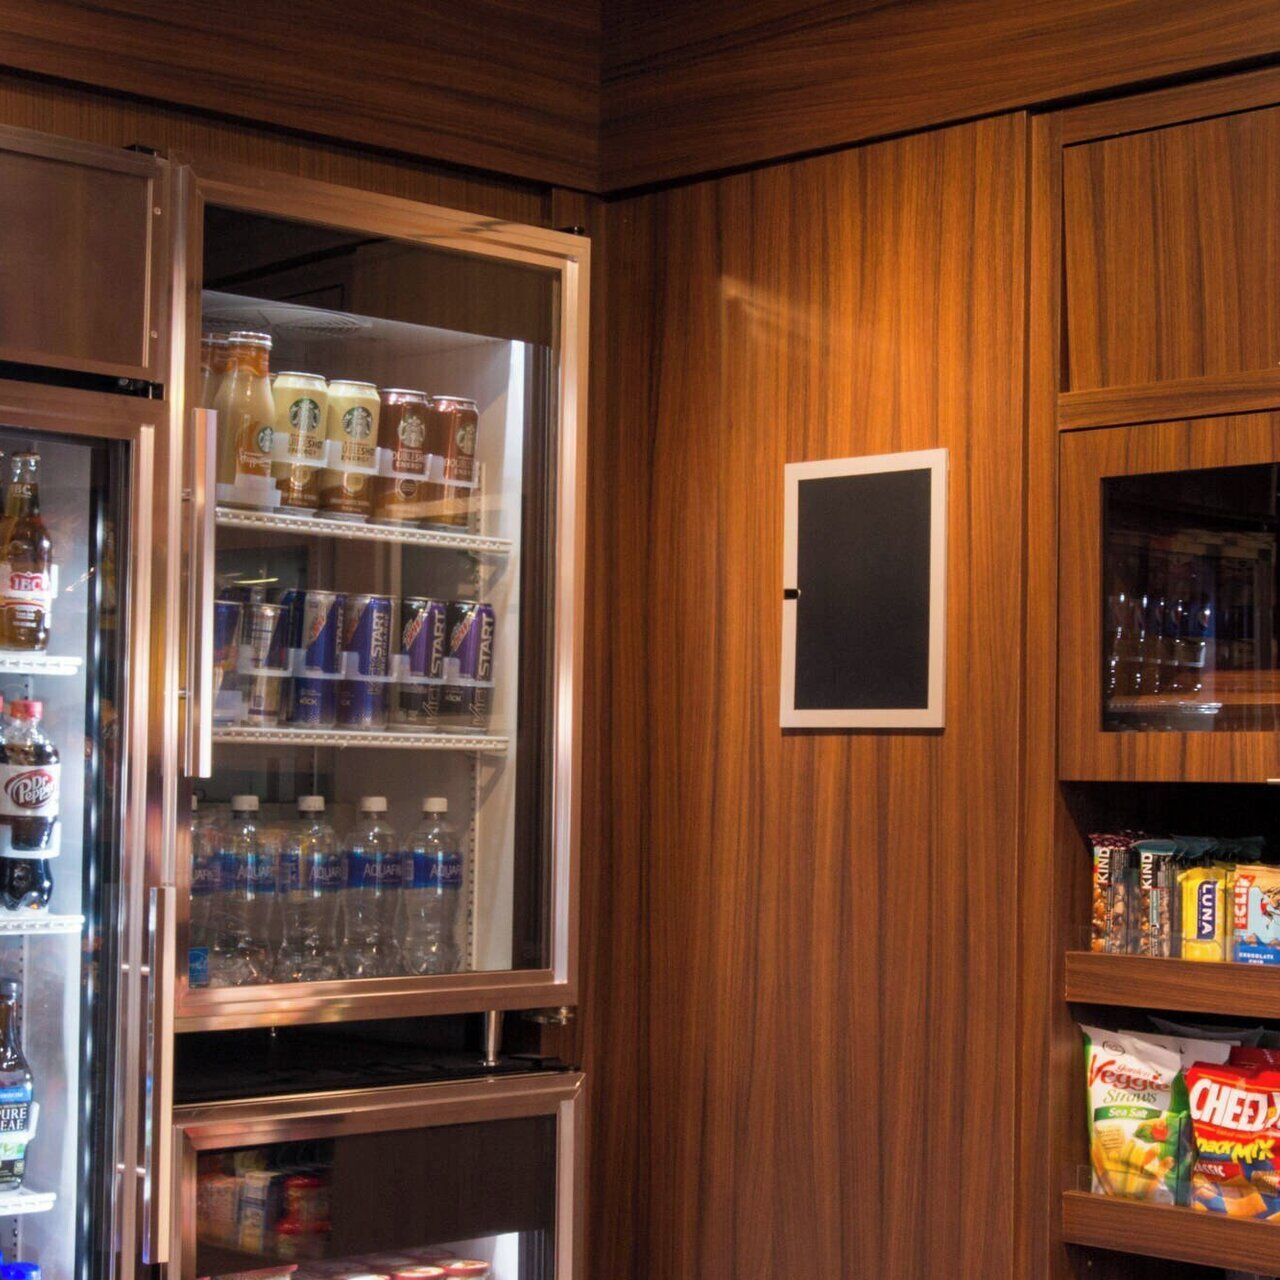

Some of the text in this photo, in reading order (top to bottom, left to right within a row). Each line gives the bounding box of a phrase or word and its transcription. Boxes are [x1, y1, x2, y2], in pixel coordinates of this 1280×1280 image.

[430, 610, 446, 679] START
[478, 613, 495, 681] START
[31, 775, 48, 788] Dr
[1097, 847, 1110, 885] KIND
[1140, 852, 1153, 890] KIND
[1201, 883, 1214, 935] LUNA
[1235, 878, 1251, 917] CLIF
[1088, 1054, 1171, 1092] Veggie
[1103, 1089, 1158, 1104] Straws
[1108, 1107, 1128, 1117] Sea
